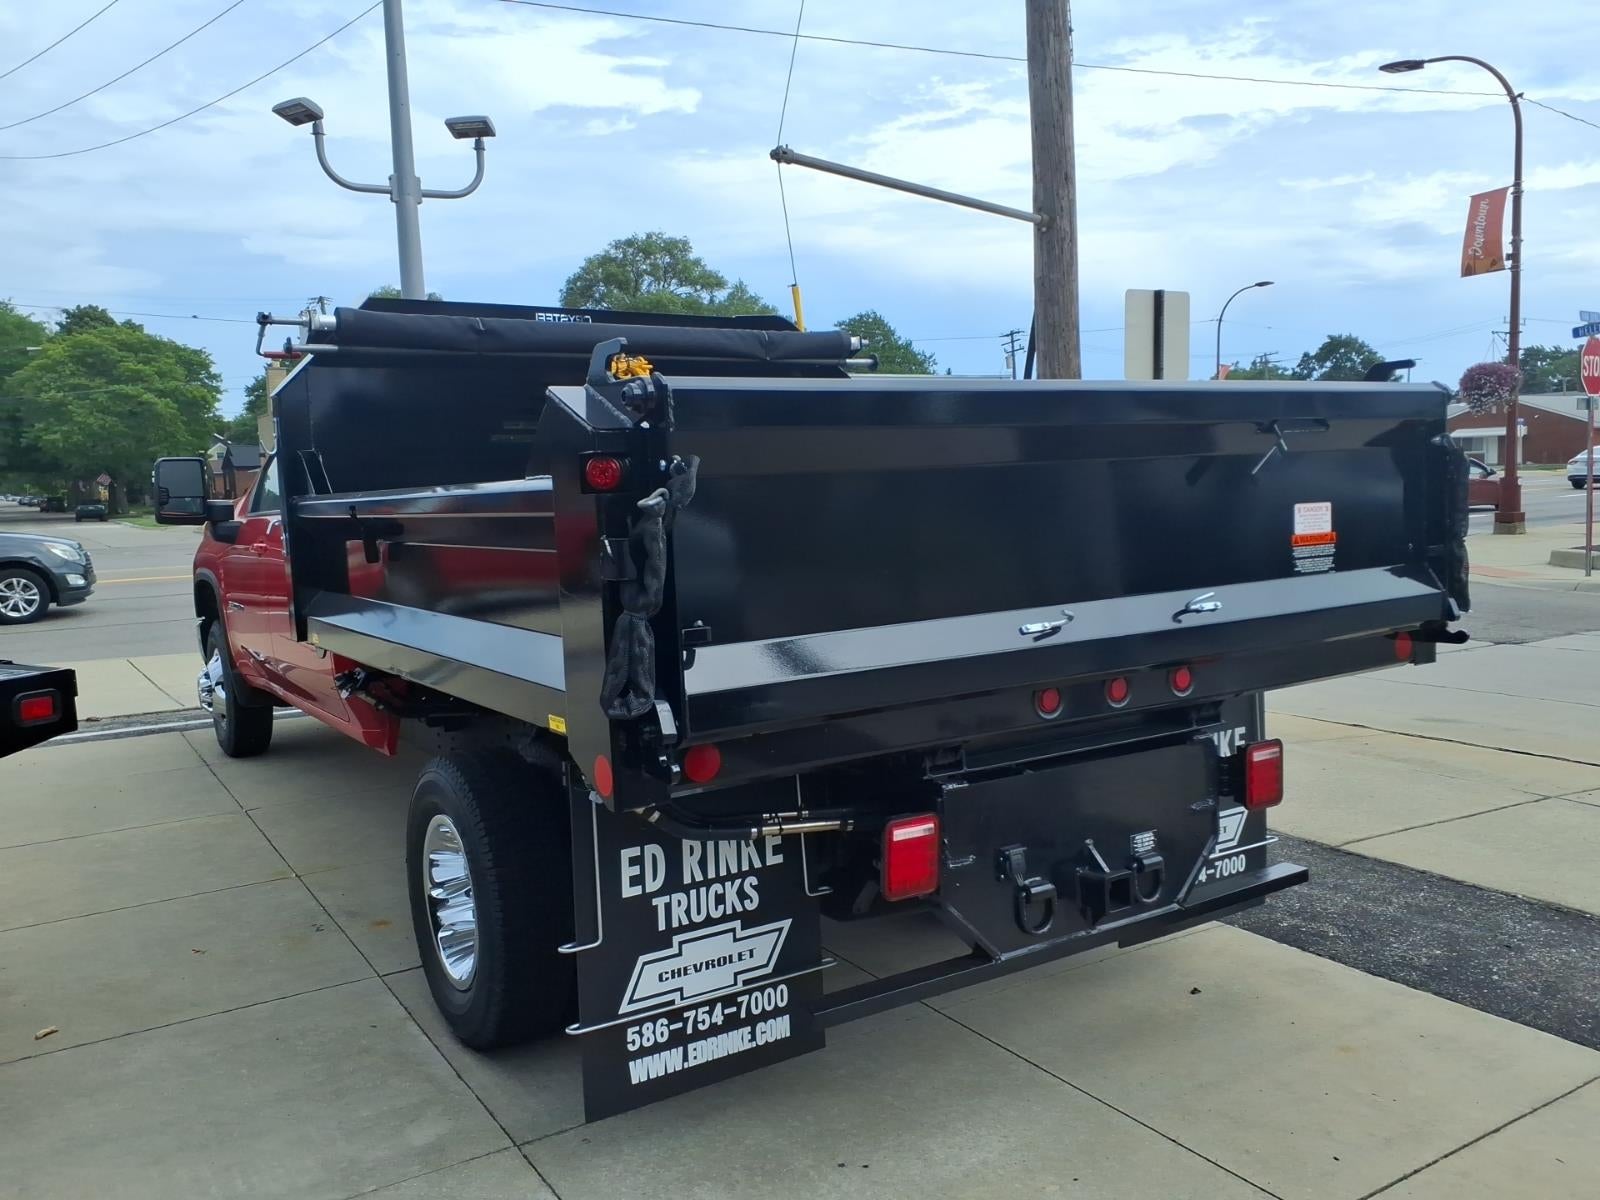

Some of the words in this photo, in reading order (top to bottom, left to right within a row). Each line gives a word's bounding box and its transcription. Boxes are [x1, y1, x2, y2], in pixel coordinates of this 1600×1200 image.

[1468, 198, 1489, 259] Downtown
[1583, 355, 1600, 377] STO
[620, 843, 666, 898] ED
[682, 835, 784, 885] RINKE
[652, 876, 760, 931] TRUCKS
[658, 948, 757, 983] CHEVROLET
[626, 984, 789, 1051] 586-754-7000
[628, 1014, 791, 1085] WWW.EDRINKE.COM
